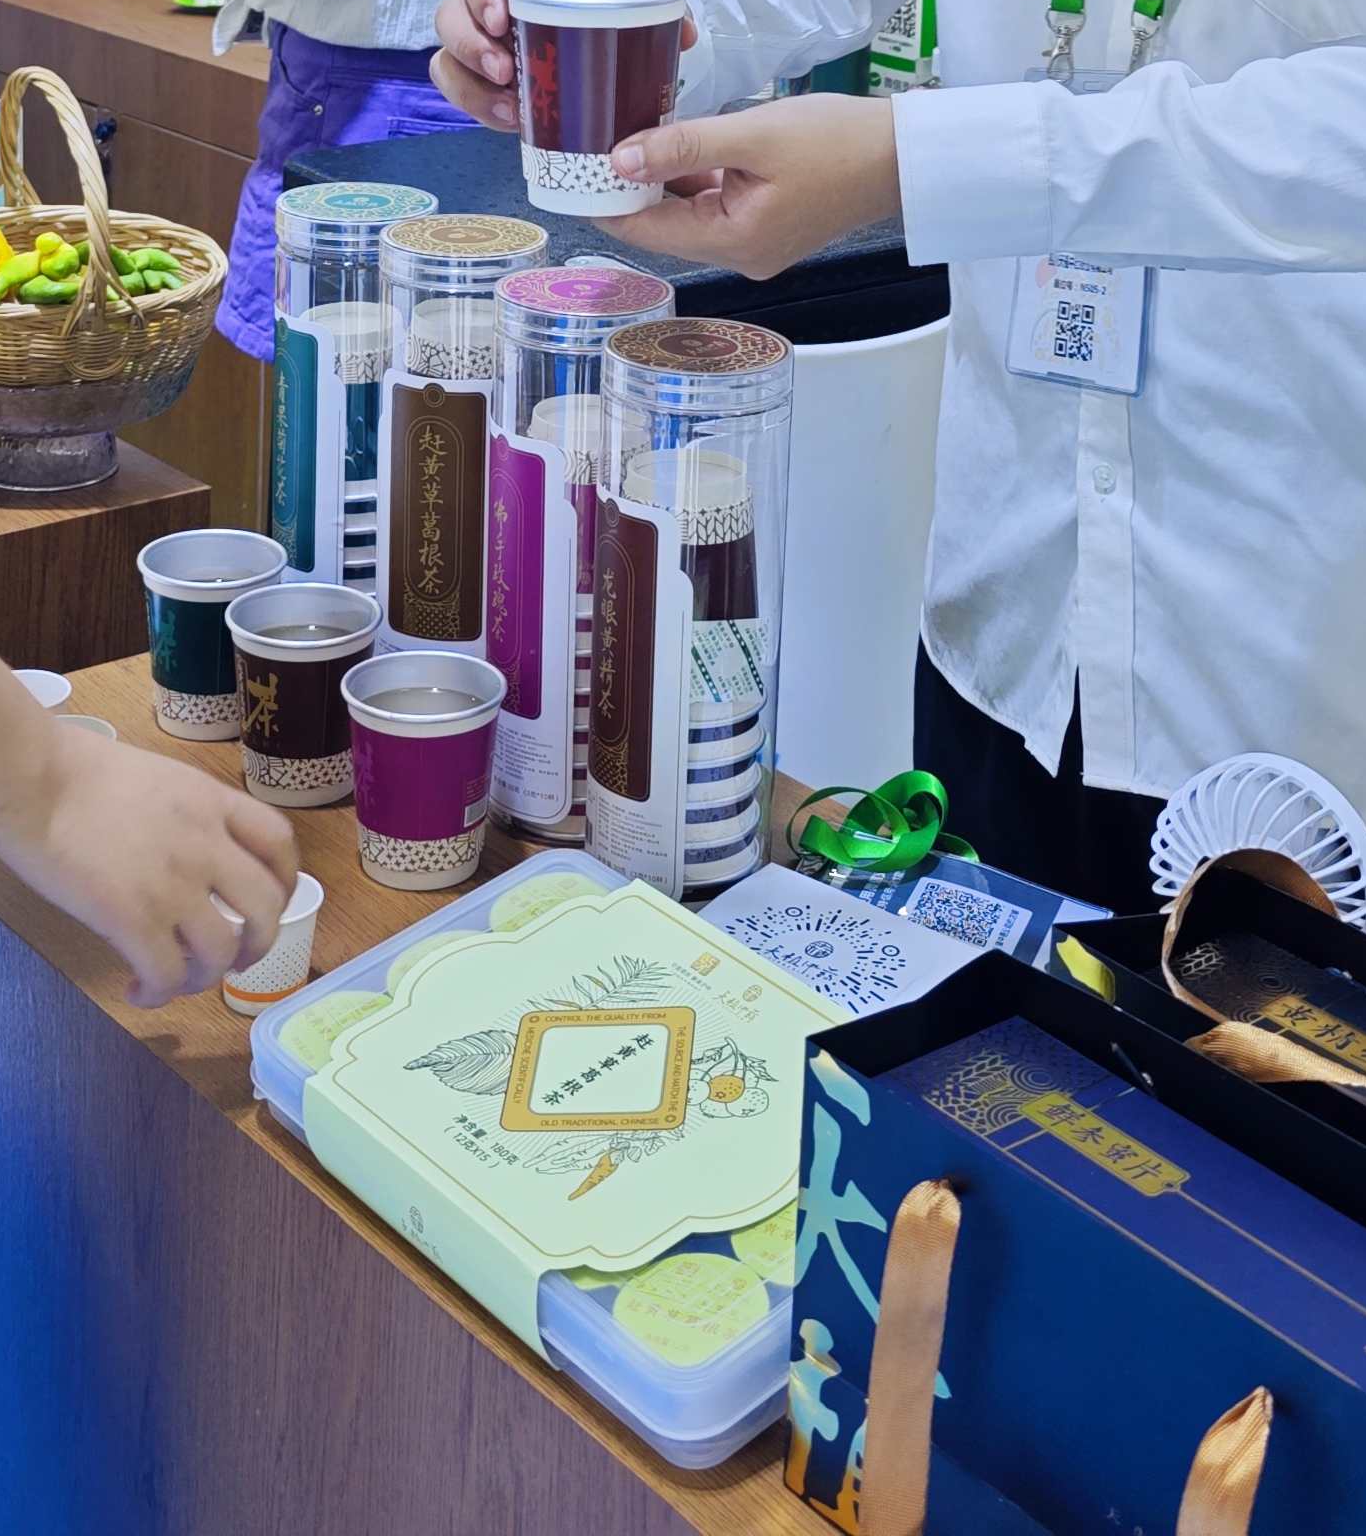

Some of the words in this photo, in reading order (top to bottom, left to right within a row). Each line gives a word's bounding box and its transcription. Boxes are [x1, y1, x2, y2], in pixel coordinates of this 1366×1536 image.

[416, 426, 447, 595] 赶黄草葛根茶
[597, 567, 619, 720] 龙眼黄精茶
[545, 1015, 582, 1023] CONTROL
[586, 1014, 601, 1022] THE
[603, 1013, 639, 1021] QUALITY
[641, 1012, 666, 1020] FROM
[541, 1031, 655, 1107] 赶黄草葛根茶
[540, 1119, 559, 1127] OLD
[561, 1118, 616, 1127] TRADITIONAL
[1034, 1098, 1167, 1185] 鲜参蜜片
